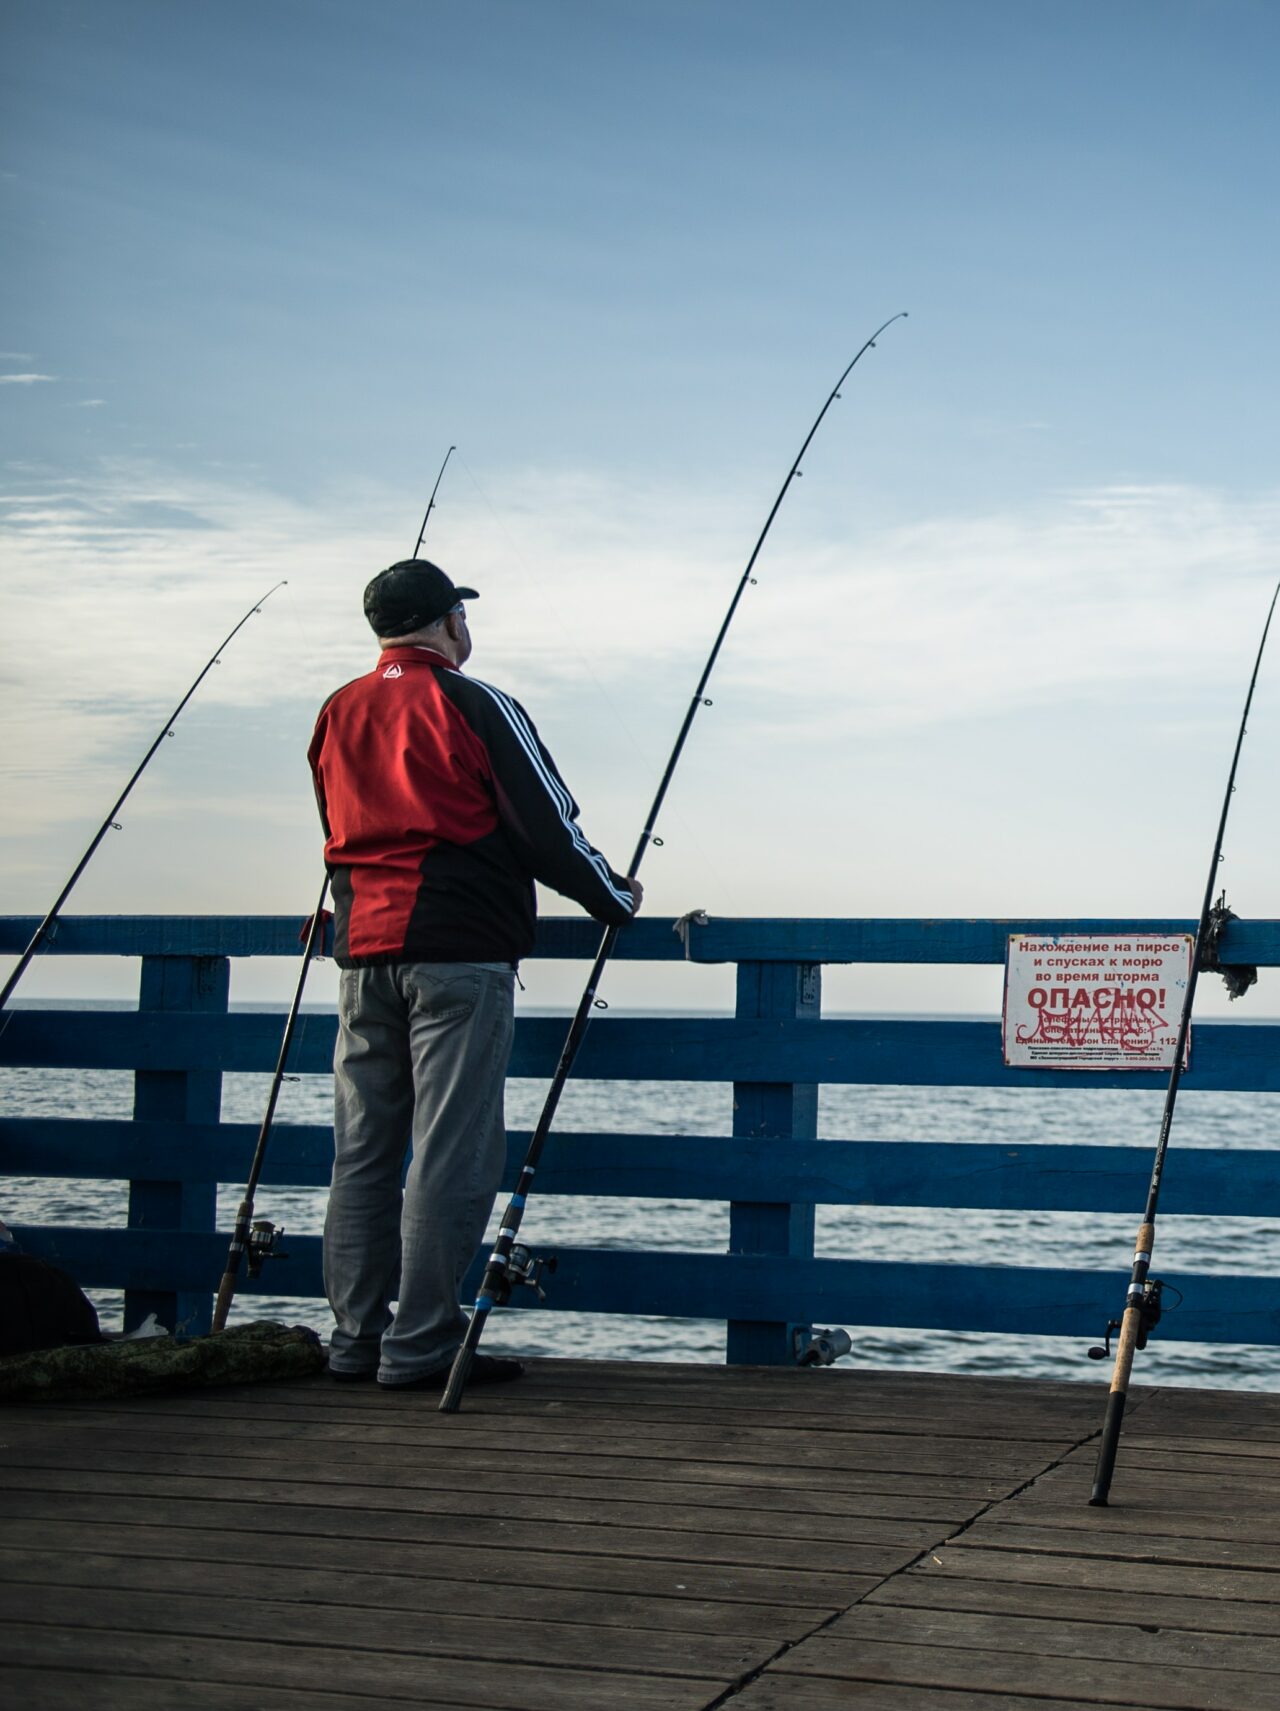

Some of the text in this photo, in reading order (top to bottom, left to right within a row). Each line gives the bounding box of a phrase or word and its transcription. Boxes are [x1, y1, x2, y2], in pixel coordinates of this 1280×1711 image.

[1019, 942, 1180, 954] Нахождение на пирсе
[1034, 957, 1163, 969] и спусках к морю
[1036, 973, 1159, 983] во время шторма
[1027, 988, 1167, 1009] ОПАСНО!
[1038, 1016, 1089, 1024] елефоы
[1045, 1027, 1105, 1035] опеативны
[1055, 1037, 1099, 1046] телон
[1159, 1037, 1177, 1045] 112
